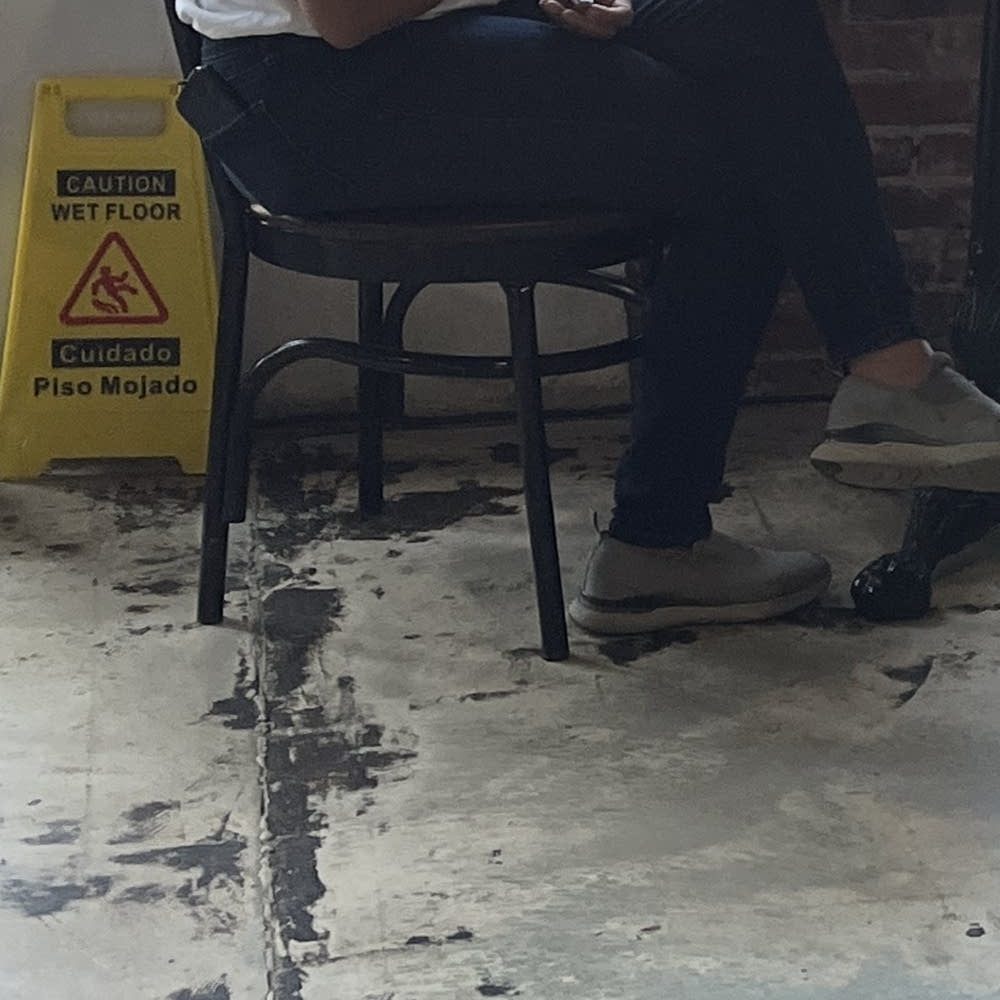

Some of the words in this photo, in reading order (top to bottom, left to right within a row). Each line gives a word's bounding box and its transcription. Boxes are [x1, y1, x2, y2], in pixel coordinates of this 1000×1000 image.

[65, 173, 167, 195] CAUTION
[51, 202, 100, 221] WET
[105, 202, 182, 221] FLOOR
[59, 343, 172, 365] Cuidado
[33, 376, 93, 397] Piso
[100, 374, 198, 400] Mojado
